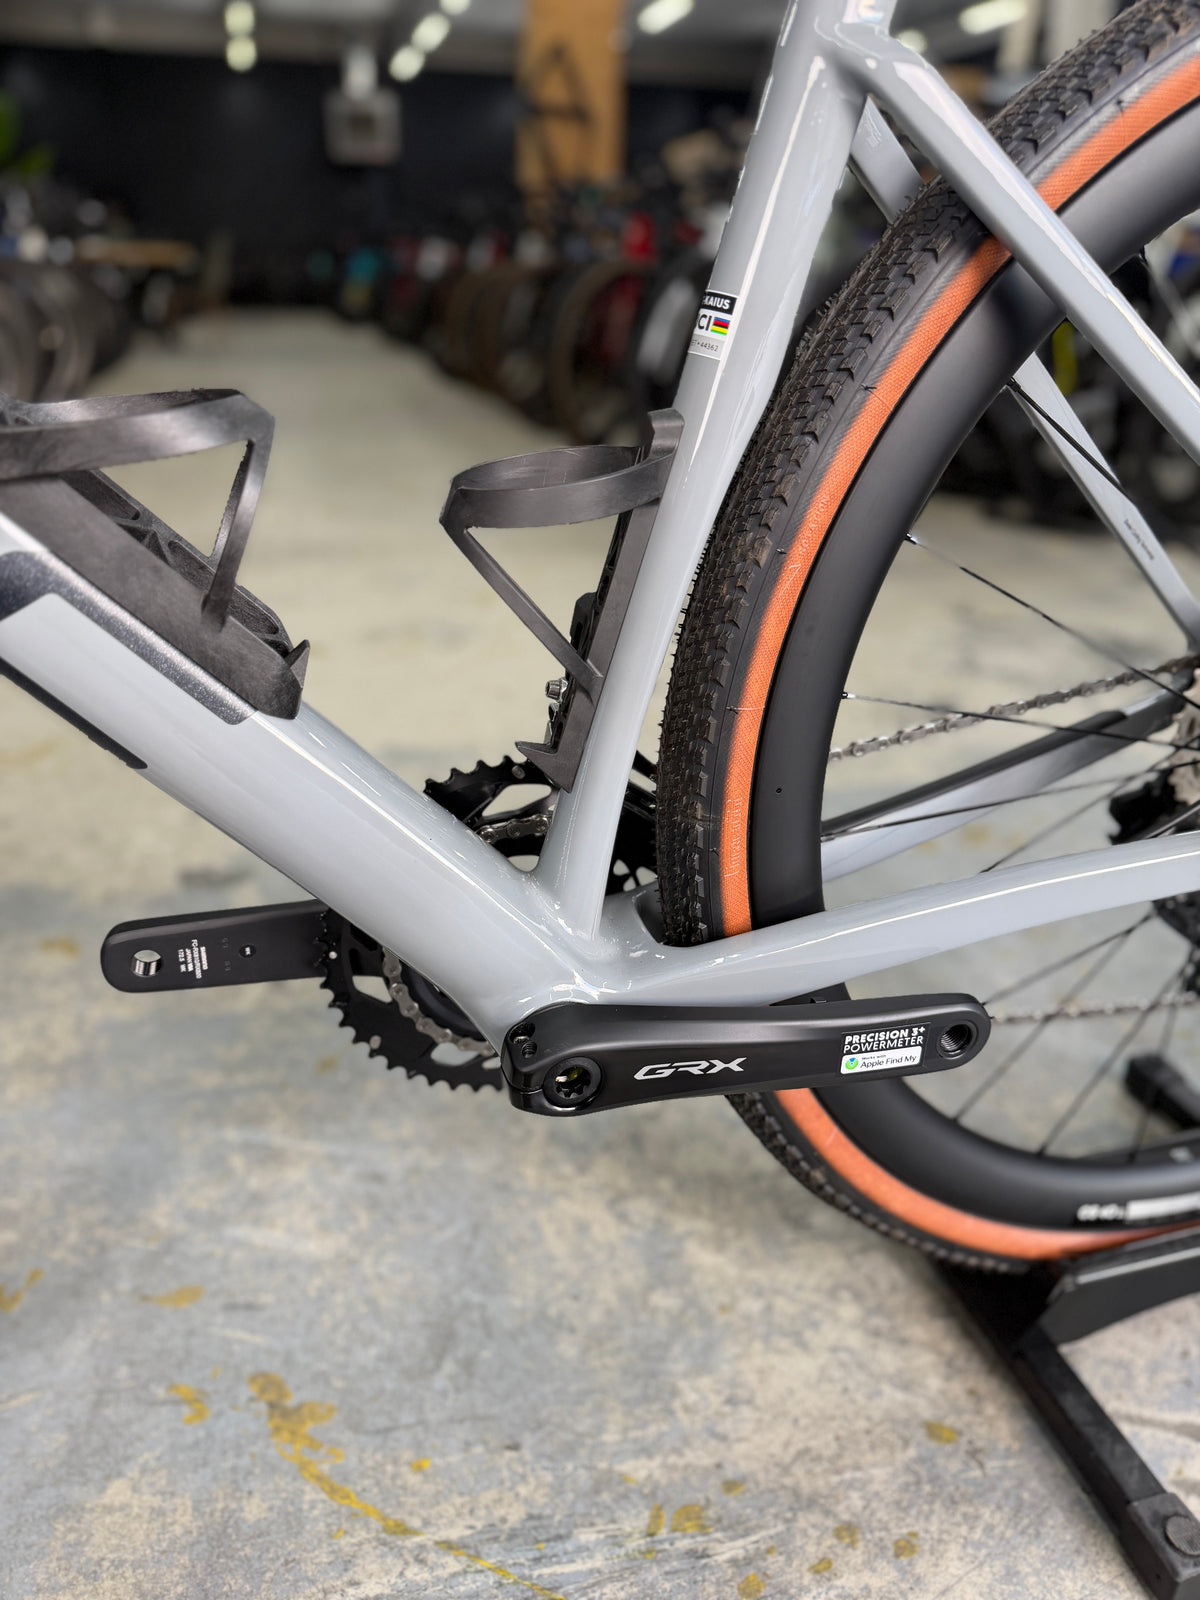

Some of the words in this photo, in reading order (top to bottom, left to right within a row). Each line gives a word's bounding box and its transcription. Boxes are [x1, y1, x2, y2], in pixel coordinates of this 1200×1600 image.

[697, 314, 712, 331] CI
[843, 1036, 924, 1054] POWERMETER
[845, 1029, 909, 1045] PRECISION
[633, 1057, 747, 1081] GRX
[860, 1060, 885, 1069] Apple
[885, 1057, 903, 1065] Find
[905, 1055, 917, 1064] My
